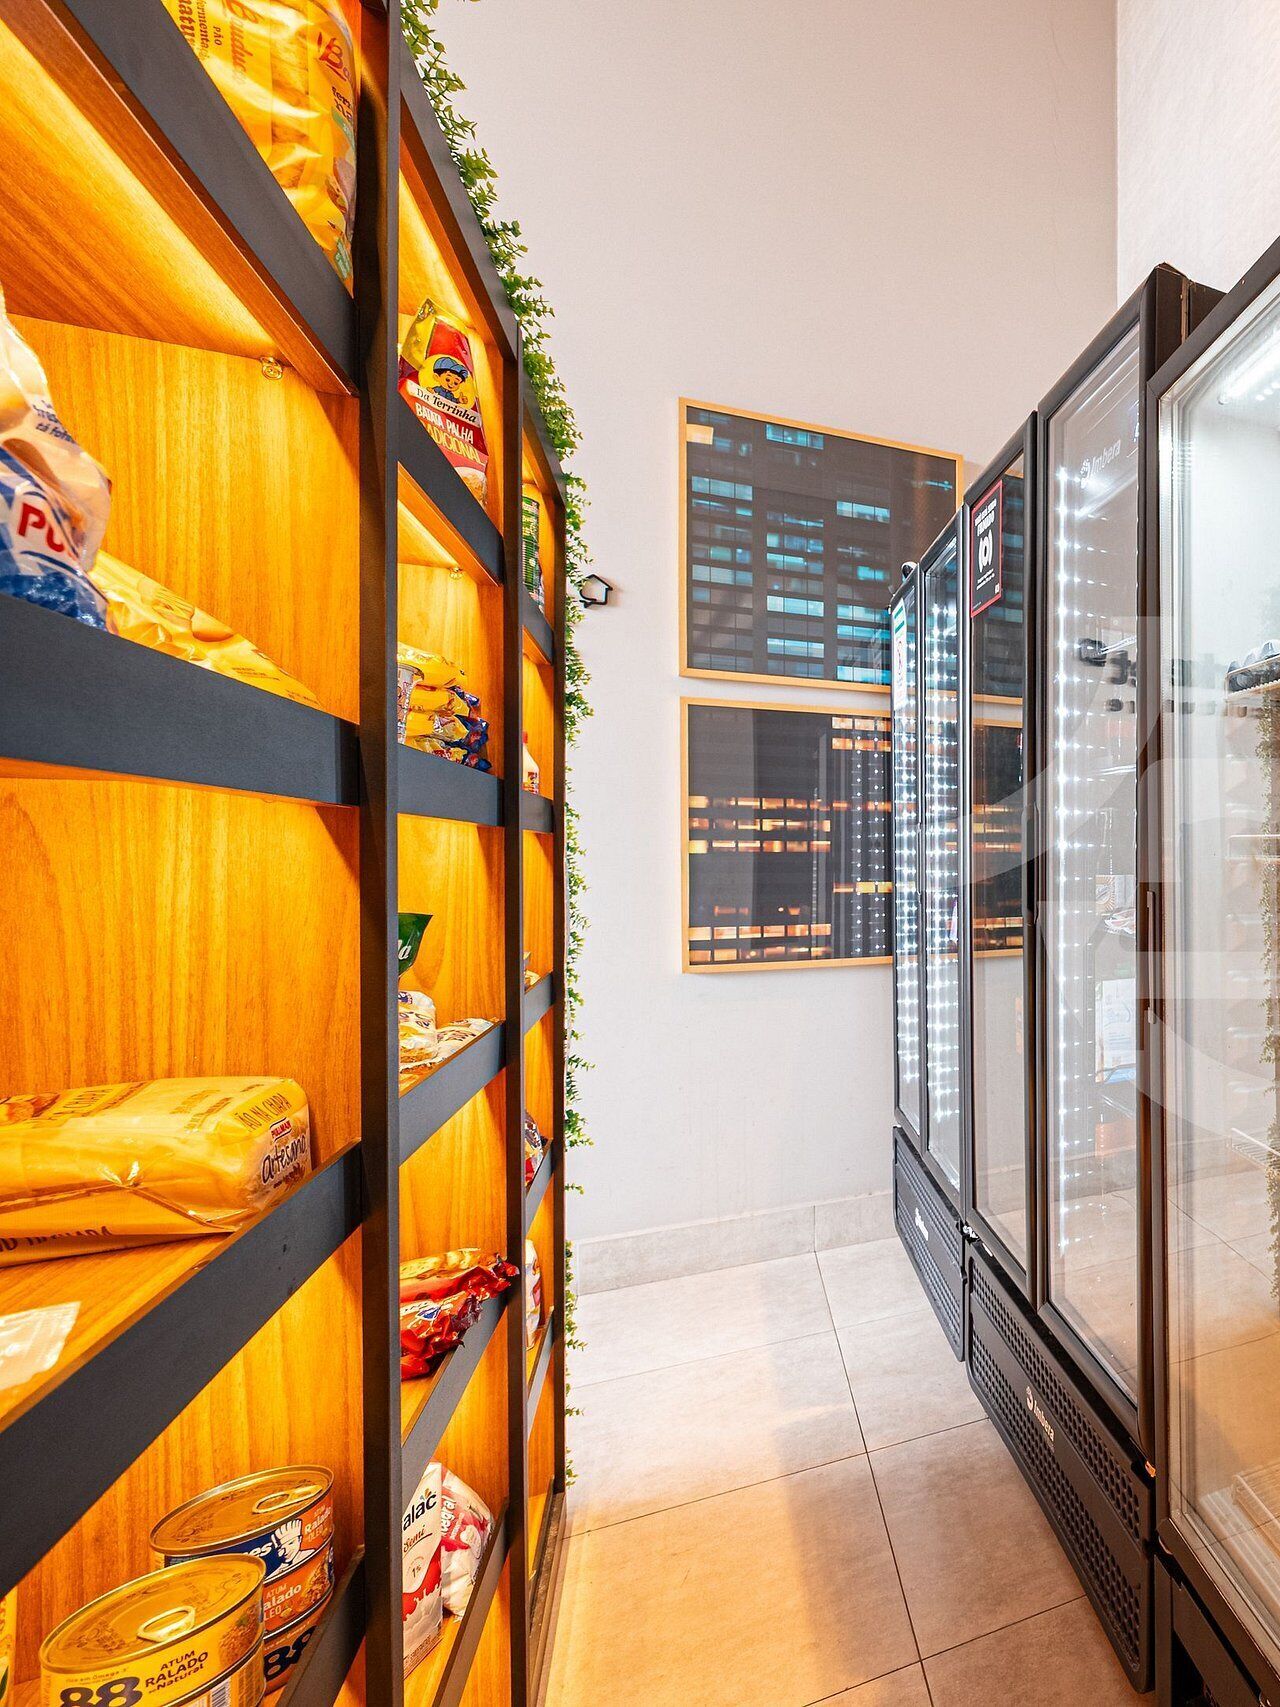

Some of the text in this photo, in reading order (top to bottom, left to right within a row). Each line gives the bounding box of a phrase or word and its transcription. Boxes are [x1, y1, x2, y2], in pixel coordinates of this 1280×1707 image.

[414, 402, 474, 444] BATATA PALHA
[416, 387, 477, 423] Da Terrinha
[422, 423, 486, 467] ADICIONAL
[402, 1494, 437, 1531] alac
[441, 1494, 457, 1534] egral
[263, 1583, 302, 1612] alado
[263, 1605, 282, 1622] LEO
[145, 1651, 209, 1688] RALADO
[157, 1663, 204, 1691] Natural
[160, 1650, 195, 1670] ATUM
